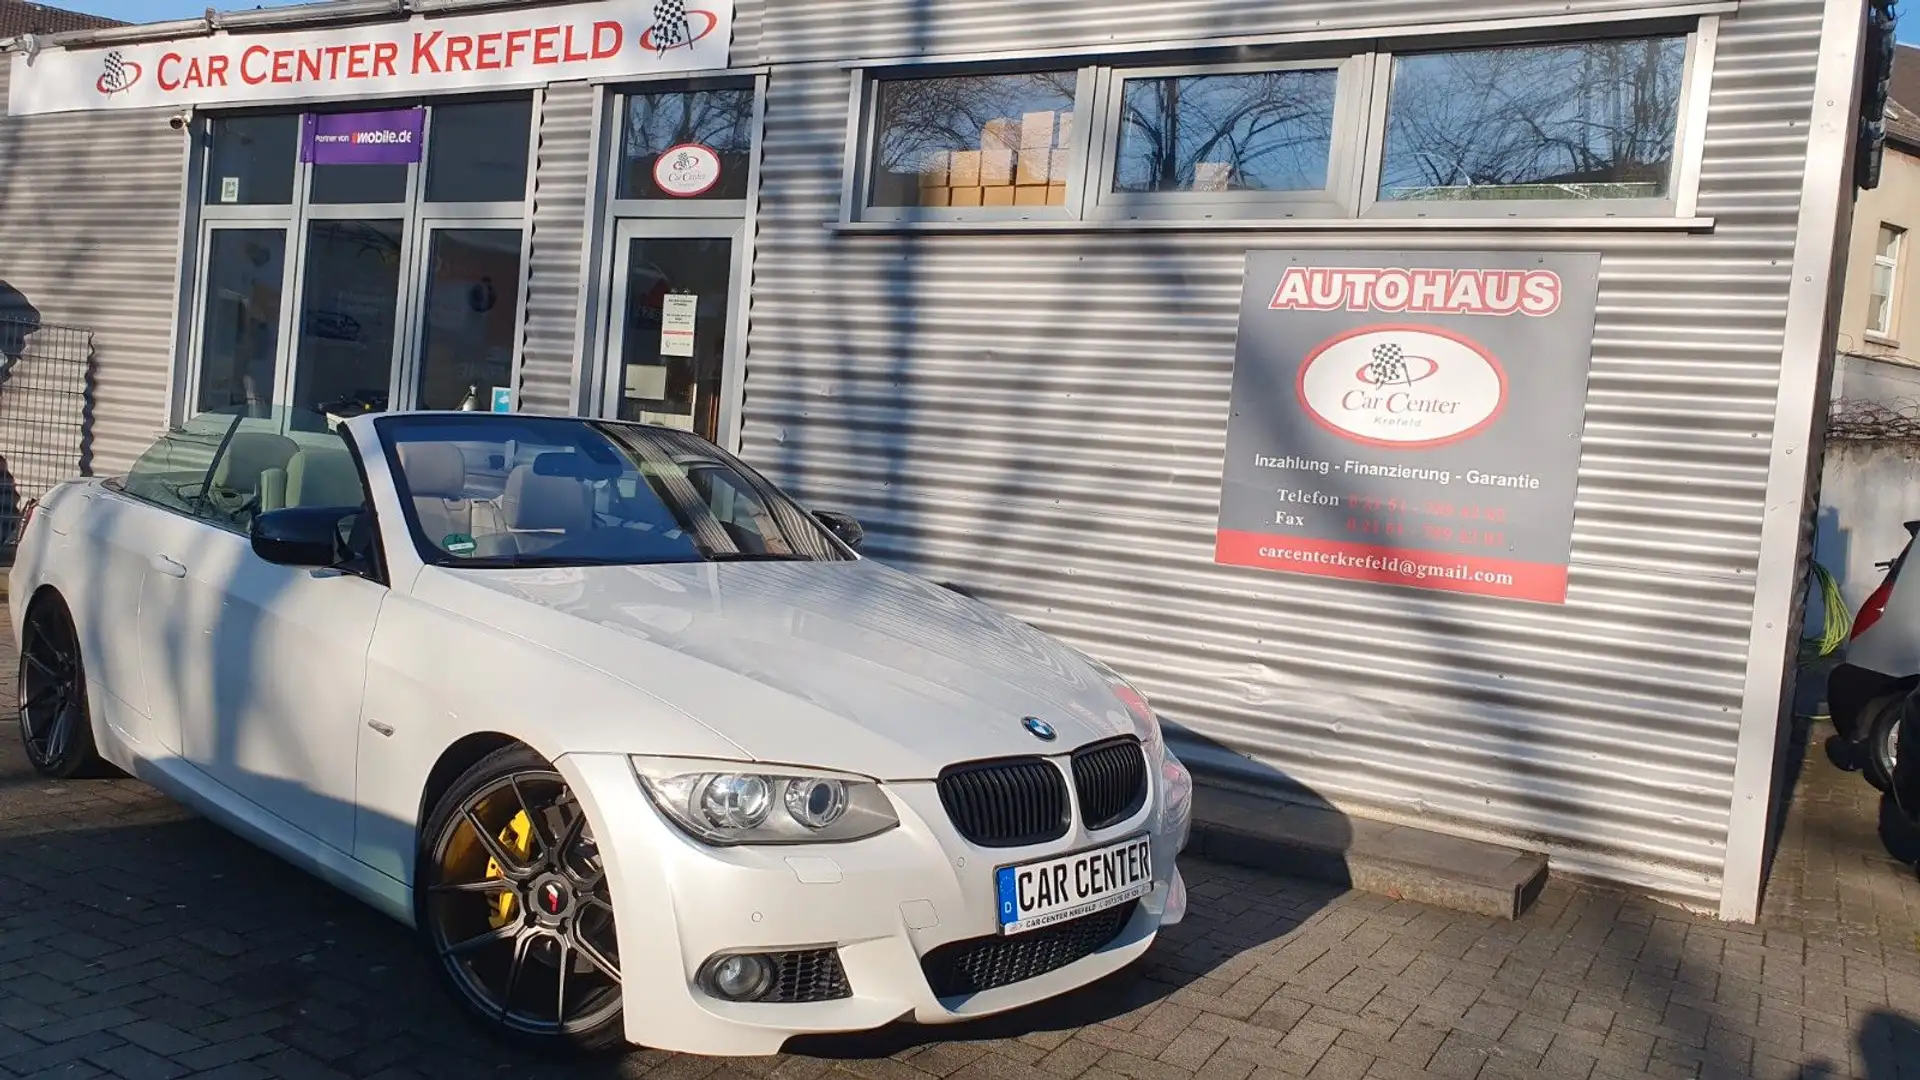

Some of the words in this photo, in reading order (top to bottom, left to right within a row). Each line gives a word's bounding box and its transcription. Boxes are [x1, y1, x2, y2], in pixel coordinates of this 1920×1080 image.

[157, 52, 229, 91] CAR
[240, 44, 399, 85] CENTER
[411, 20, 623, 75] KREFELD
[357, 130, 411, 143] mobile.de
[1268, 267, 1561, 316] AUTOHAUS
[1341, 389, 1383, 411] Car
[1386, 391, 1461, 414] Center
[1255, 454, 1329, 474] Inzahlung
[1344, 460, 1450, 484] Finanzierung
[1466, 470, 1540, 490] Garantie
[1277, 488, 1340, 507] Telefon
[1275, 511, 1305, 527] Fax
[1259, 545, 1513, 586] carcenterkrefeld@gmail.com
[1018, 863, 1068, 911] CAR
[1075, 842, 1150, 898] CENTER
[1004, 901, 1012, 914] D
[1026, 918, 1041, 928] CAR
[1041, 912, 1068, 924] CENTER
